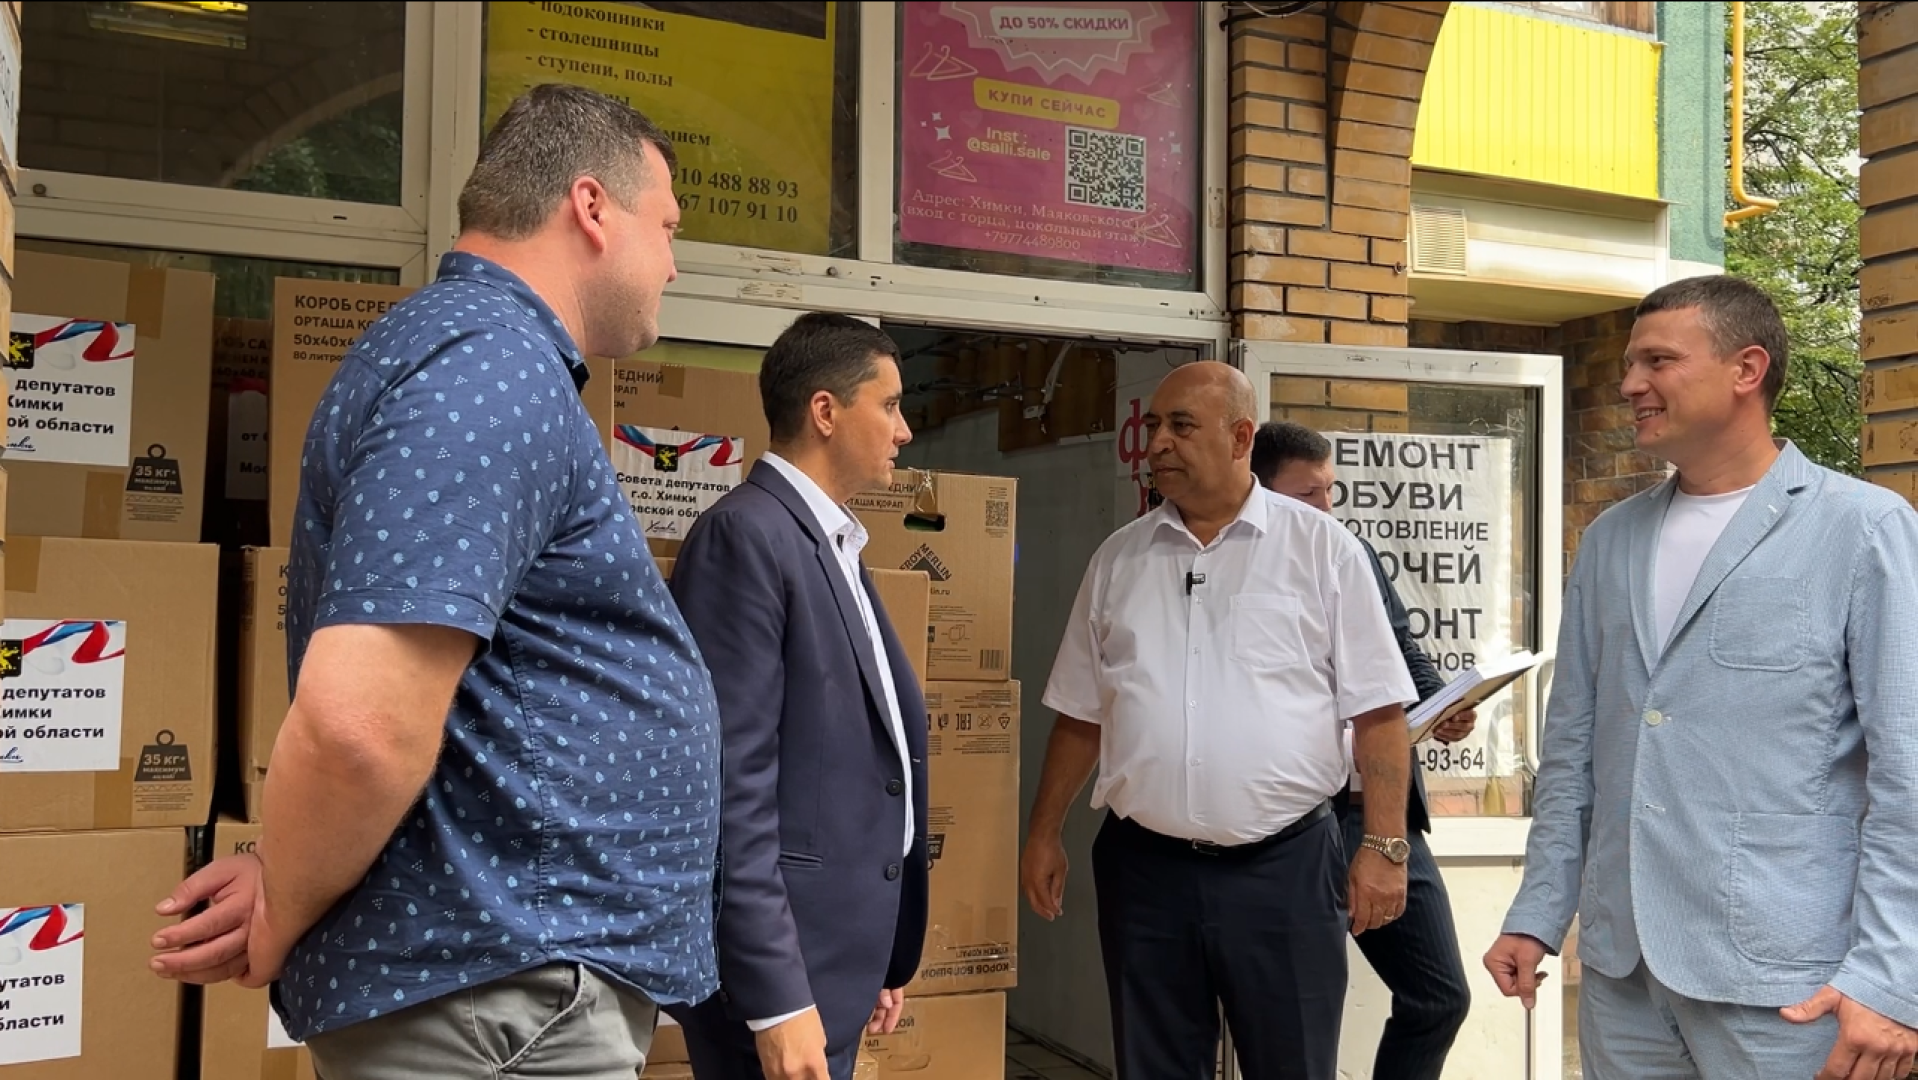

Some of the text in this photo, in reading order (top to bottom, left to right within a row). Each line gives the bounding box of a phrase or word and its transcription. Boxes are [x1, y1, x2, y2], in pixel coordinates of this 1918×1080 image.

[540, 2, 666, 32] подоконники
[999, 16, 1129, 32] ДО 50% СКИДКИ
[539, 27, 660, 58] столешницы
[537, 54, 619, 81] ступени,
[624, 68, 673, 88] полы
[988, 89, 1107, 120] КУПИ СЕЙЧАС
[986, 126, 1019, 142] Inst
[967, 137, 1051, 162] @salli.sale
[708, 171, 742, 193] 488
[748, 174, 771, 195] 88
[777, 180, 799, 199] 93
[912, 188, 966, 210] Адрес:
[708, 197, 741, 217] 107
[746, 200, 768, 220] 91
[777, 204, 798, 223] 10
[900, 201, 945, 222] (вход
[947, 208, 957, 219] с
[961, 211, 1011, 231] торца,
[1015, 218, 1103, 240] цокольный
[984, 231, 1082, 251] +79774489800
[294, 295, 352, 312] КОРОБ
[294, 315, 355, 330] ОРТАША
[293, 350, 307, 360] 80
[15, 378, 117, 397] депутатов
[35, 415, 115, 435] области
[1335, 438, 1481, 471] ЕМОНТ
[135, 465, 152, 476] 35
[617, 472, 731, 492] Совета депутатов
[631, 490, 697, 503] г.о. Химки
[1331, 480, 1464, 510] ОБУВИ
[919, 542, 952, 580] MERLIN
[3, 687, 107, 702] депутатов
[1, 706, 53, 719] имки
[23, 724, 104, 740] области
[143, 753, 161, 766] 35
[976, 962, 1009, 975] КОРОБ
